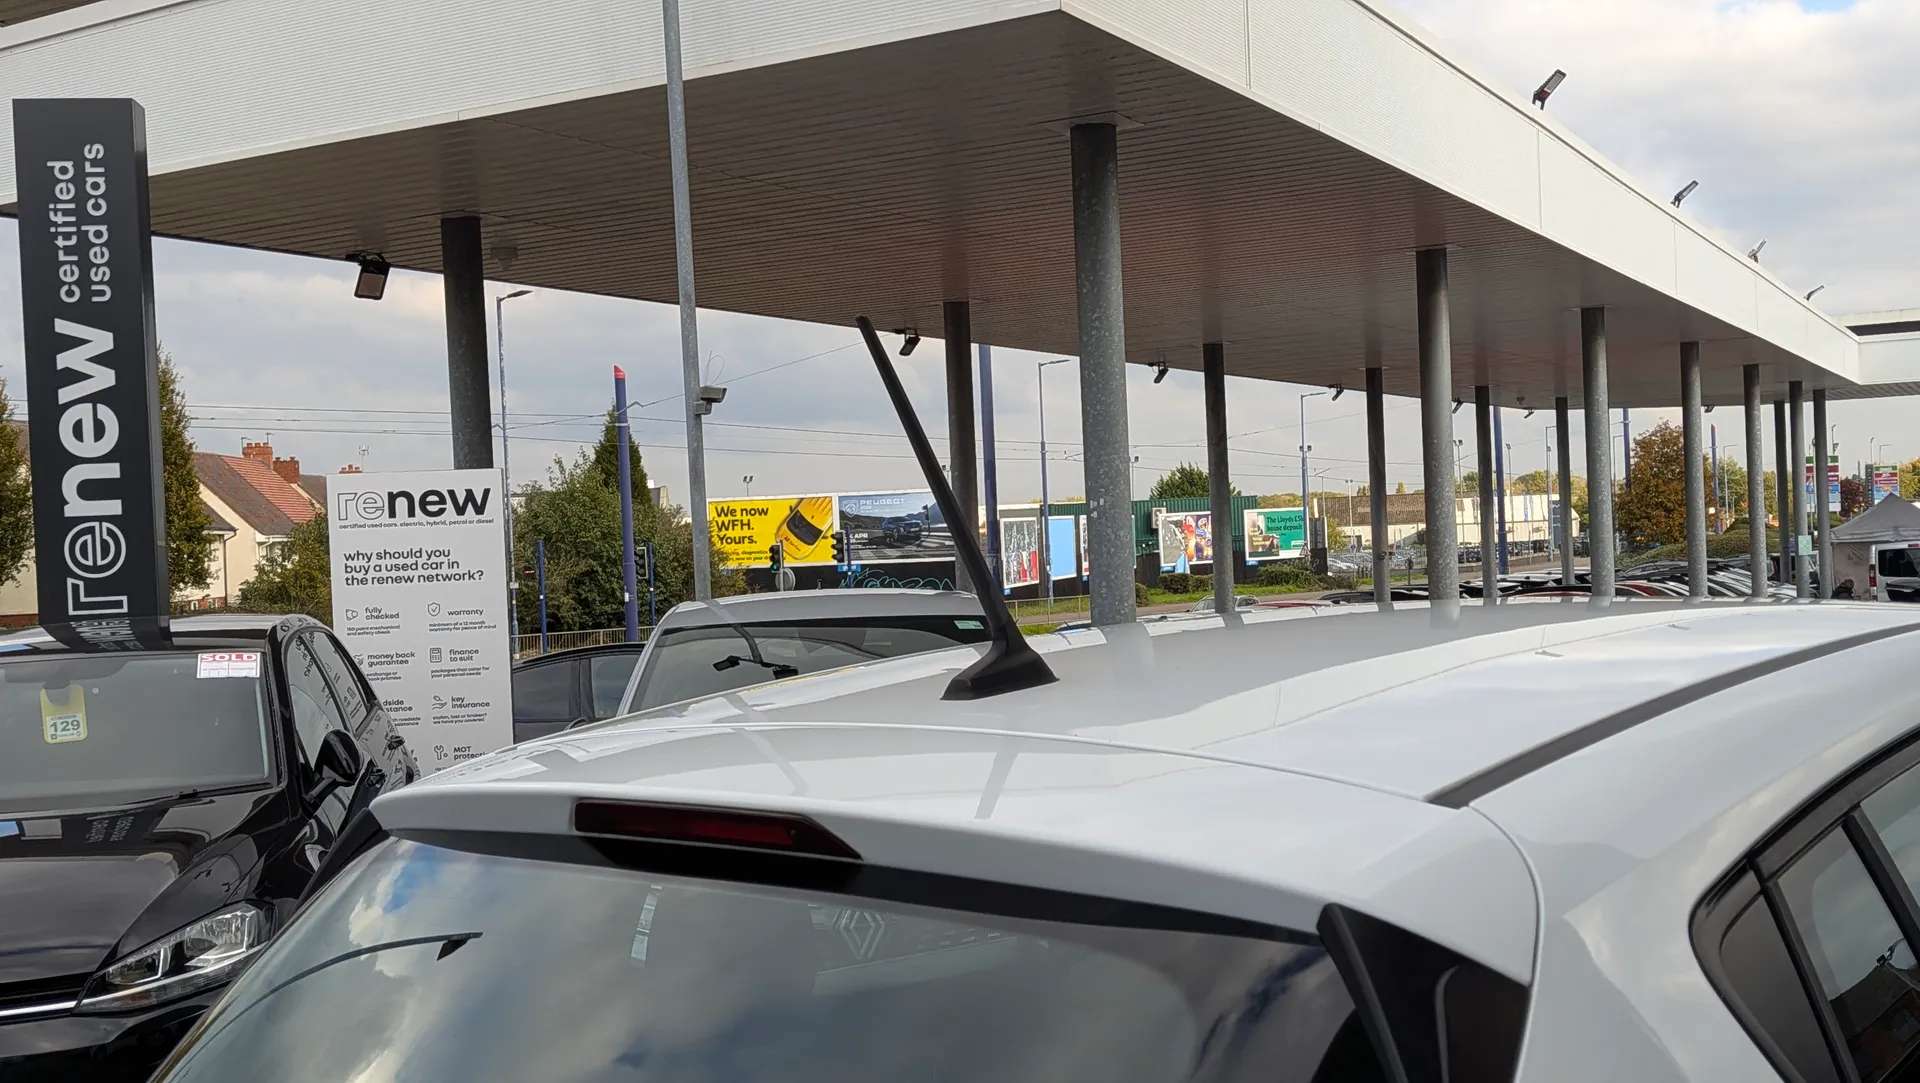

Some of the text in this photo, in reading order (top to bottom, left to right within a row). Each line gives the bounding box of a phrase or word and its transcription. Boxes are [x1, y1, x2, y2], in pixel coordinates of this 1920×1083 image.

[81, 143, 113, 303] used cars
[47, 160, 82, 304] certified
[54, 317, 129, 616] renew
[336, 488, 492, 521] renew
[714, 505, 769, 518] We now
[715, 519, 755, 532] WFH.
[716, 533, 758, 546] Yours.
[343, 547, 451, 564] why should you
[344, 558, 460, 576] buy a used car in
[344, 569, 484, 587] the renew network?
[364, 606, 383, 615] fully
[447, 608, 485, 617] warranty
[365, 612, 400, 621] checked
[200, 653, 258, 662] SOLD
[367, 651, 416, 661] money back
[448, 648, 480, 657] finance
[367, 659, 410, 668] guarantee
[382, 699, 405, 707] dside
[451, 696, 465, 704] key
[451, 701, 491, 709] insurance
[49, 719, 81, 733] 129
[453, 745, 472, 753] MOT
